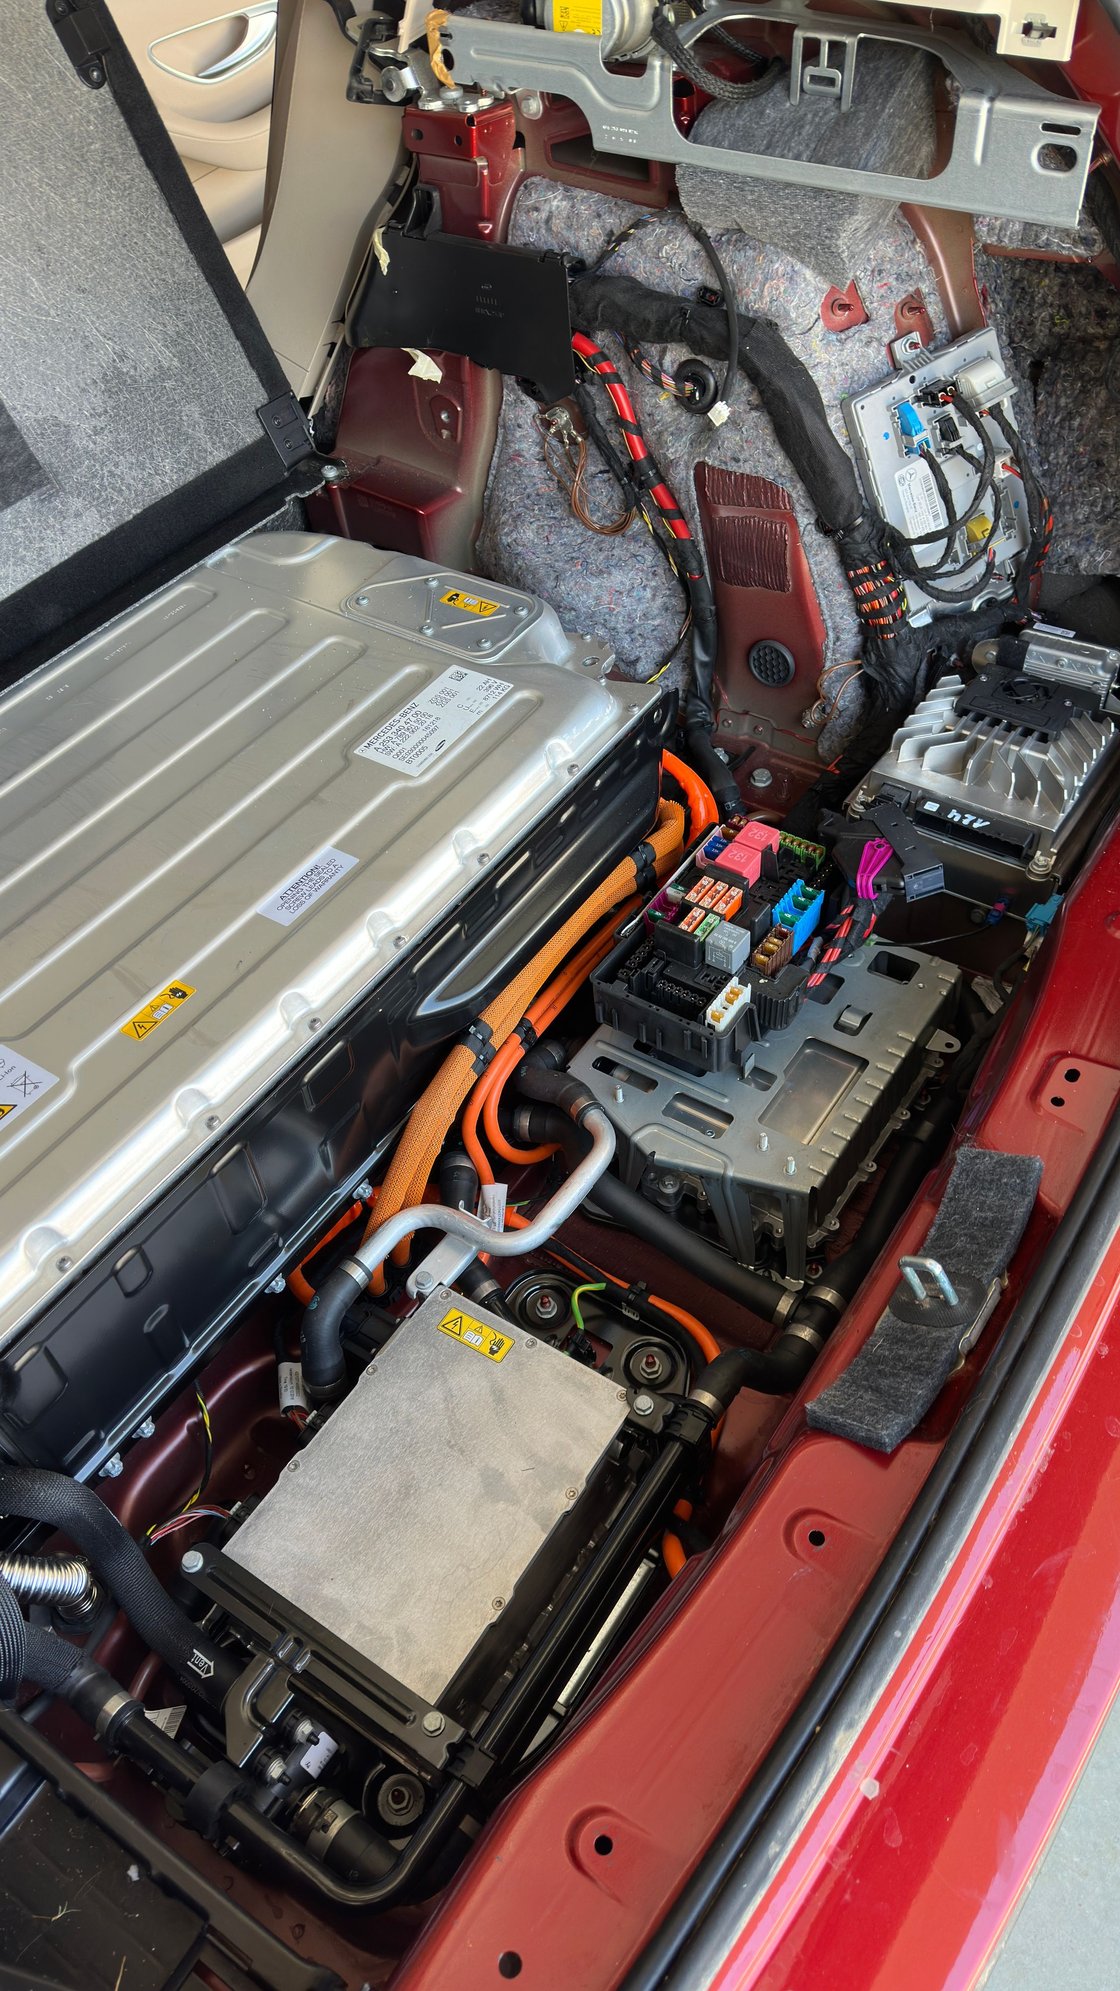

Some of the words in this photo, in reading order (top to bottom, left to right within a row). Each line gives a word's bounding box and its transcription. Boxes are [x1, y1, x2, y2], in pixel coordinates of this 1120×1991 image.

[363, 702, 420, 749] MERCEDES-BENZ
[379, 736, 394, 747] 253
[391, 725, 406, 736] 340
[410, 710, 423, 718] 00
[276, 888, 304, 911] OPENING
[302, 877, 316, 888] THE
[314, 858, 337, 877] SEALED
[279, 865, 321, 901] ATTENTION!
[284, 892, 307, 911] SCREW
[305, 876, 326, 892] LEADS
[323, 868, 334, 876] TO
[289, 900, 306, 914] LOSS
[312, 865, 345, 893] WARRANTY
[190, 1653, 209, 1674] Vent
